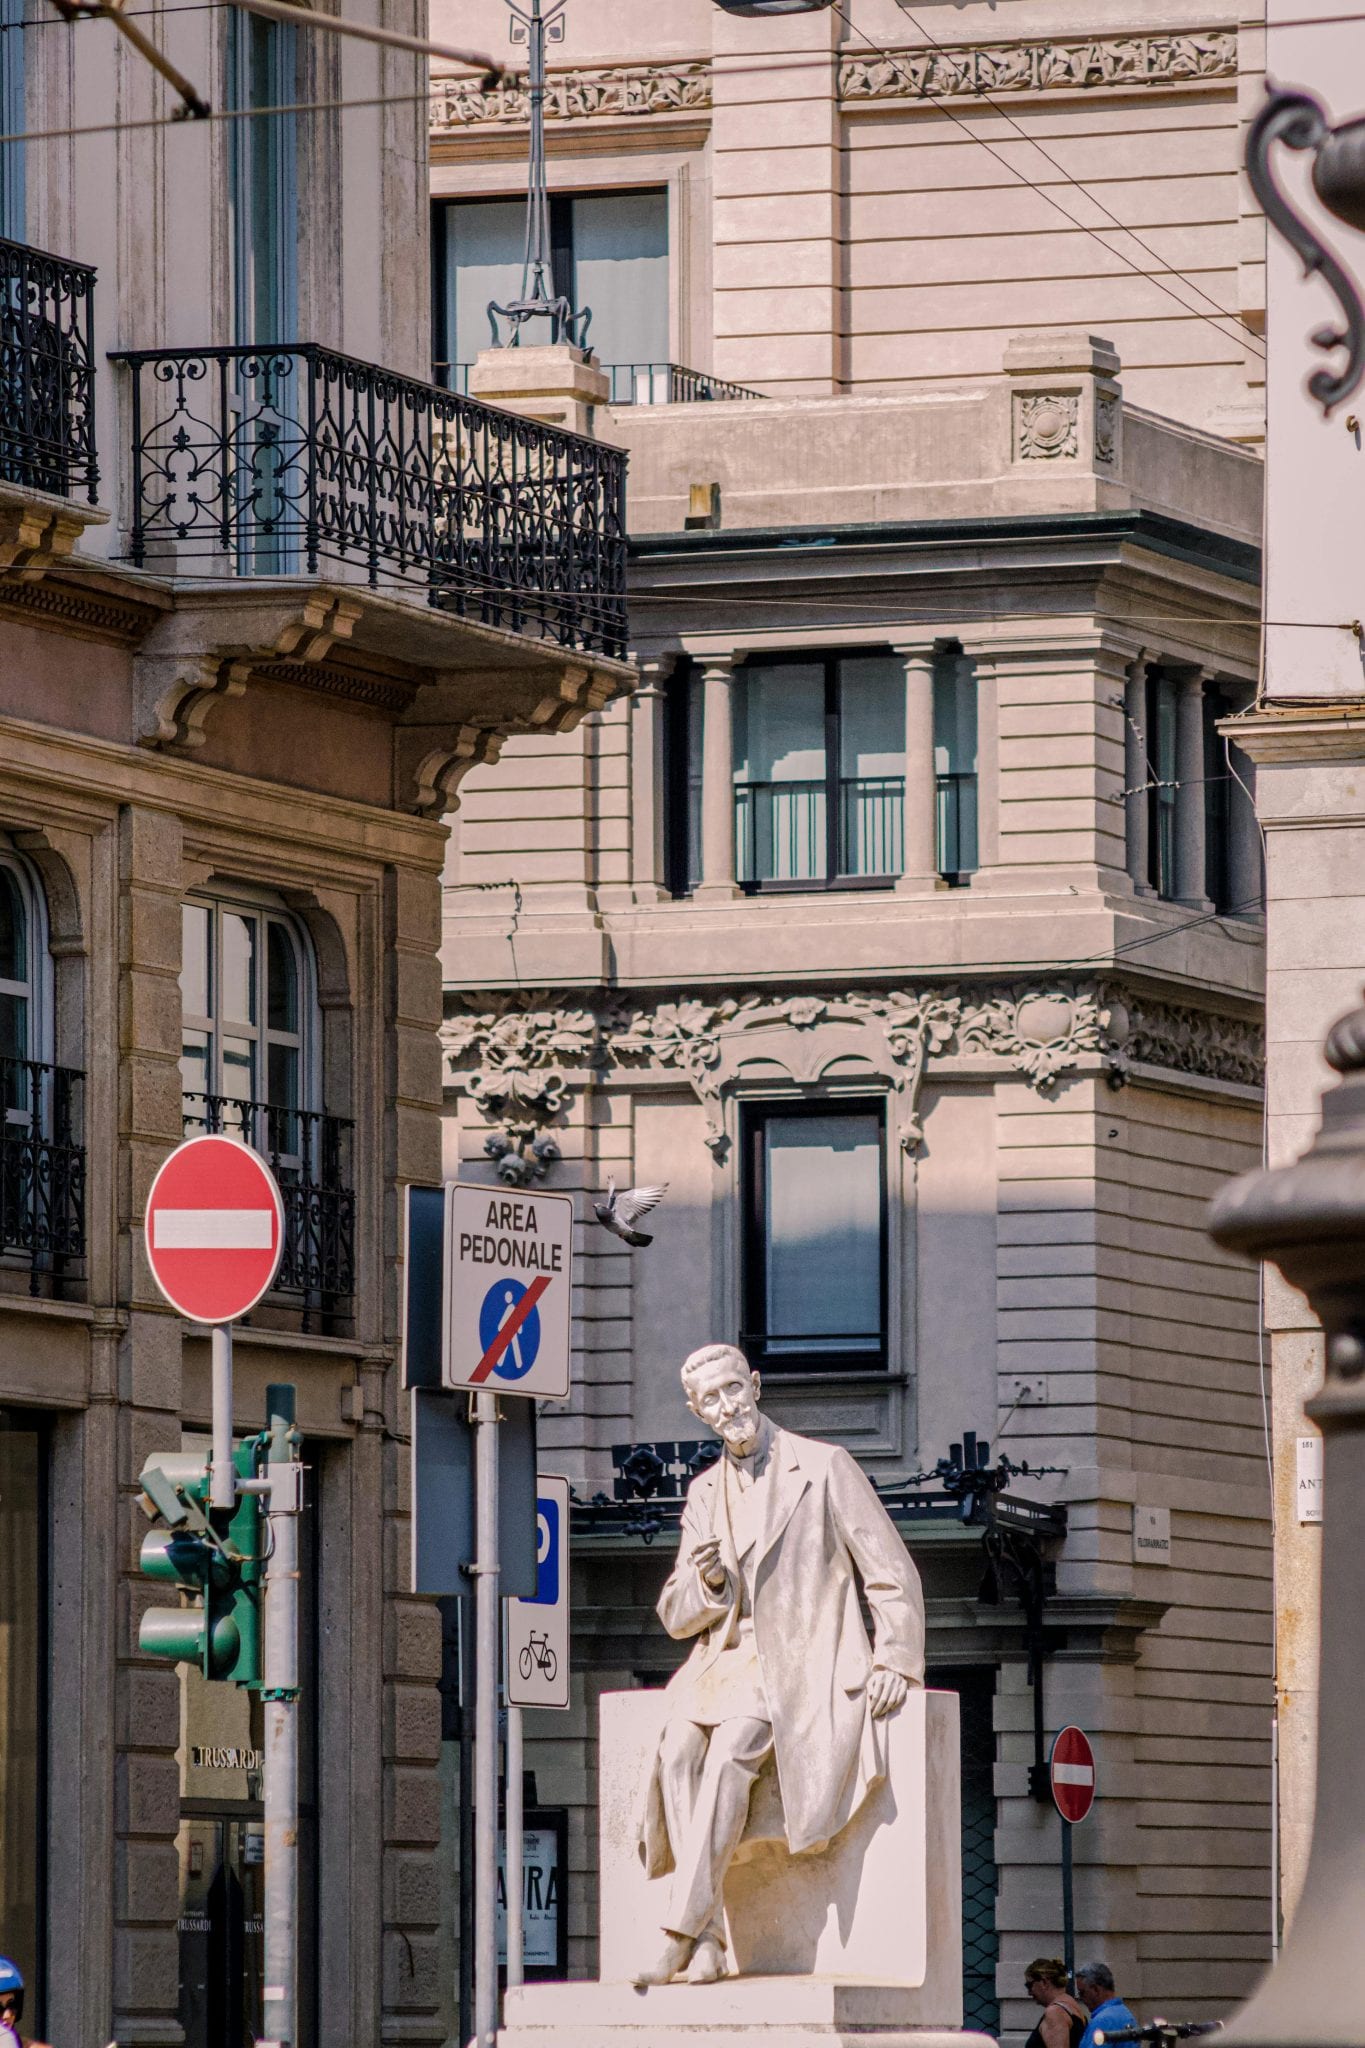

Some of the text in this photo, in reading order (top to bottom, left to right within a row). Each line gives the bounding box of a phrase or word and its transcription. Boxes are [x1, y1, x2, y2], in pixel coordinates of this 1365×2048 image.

[485, 1200, 538, 1233] AREA
[460, 1232, 562, 1273] PEDONALE
[197, 1746, 259, 1769] TRUSSARDI
